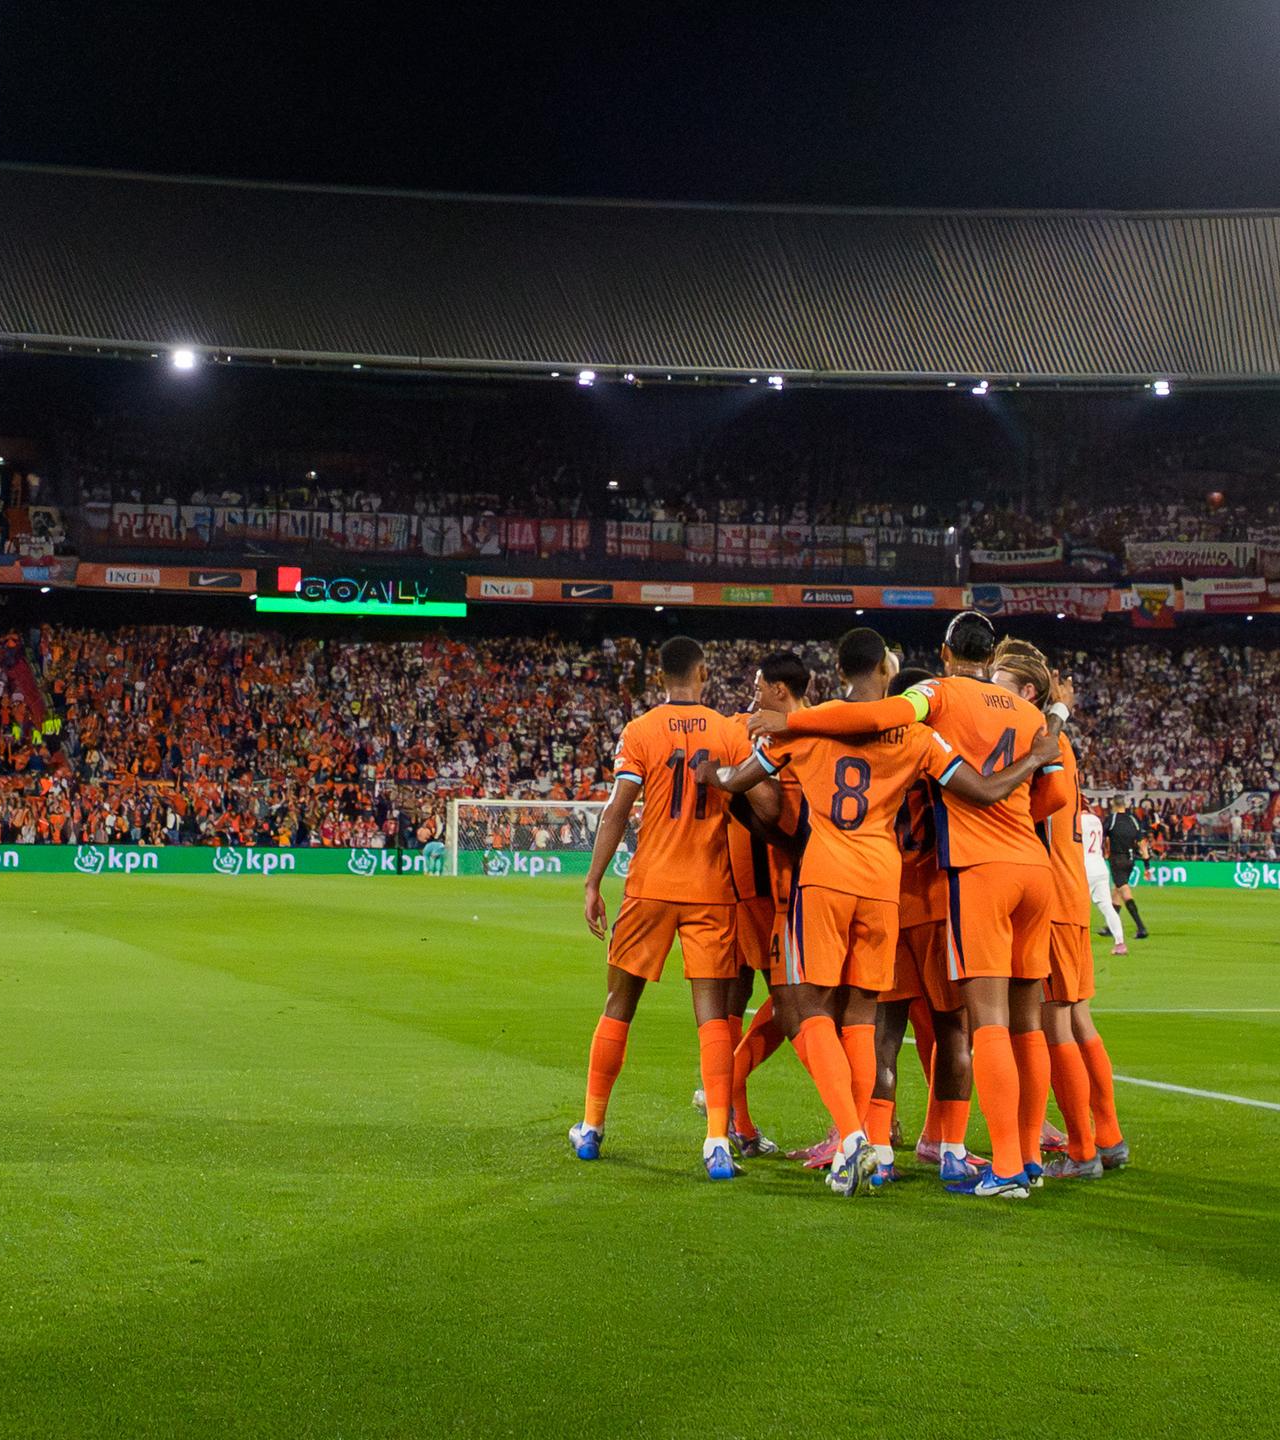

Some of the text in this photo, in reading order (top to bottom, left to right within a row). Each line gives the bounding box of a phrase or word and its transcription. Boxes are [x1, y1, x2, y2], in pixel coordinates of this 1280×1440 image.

[109, 570, 137, 583] ING
[483, 583, 511, 596] ING
[982, 693, 1017, 711] VIRGIL
[982, 727, 1016, 776] 4
[666, 748, 709, 820] 11
[830, 755, 871, 831] 8
[108, 847, 158, 873] kpn
[247, 848, 295, 875] kpn
[514, 851, 561, 877] kpn
